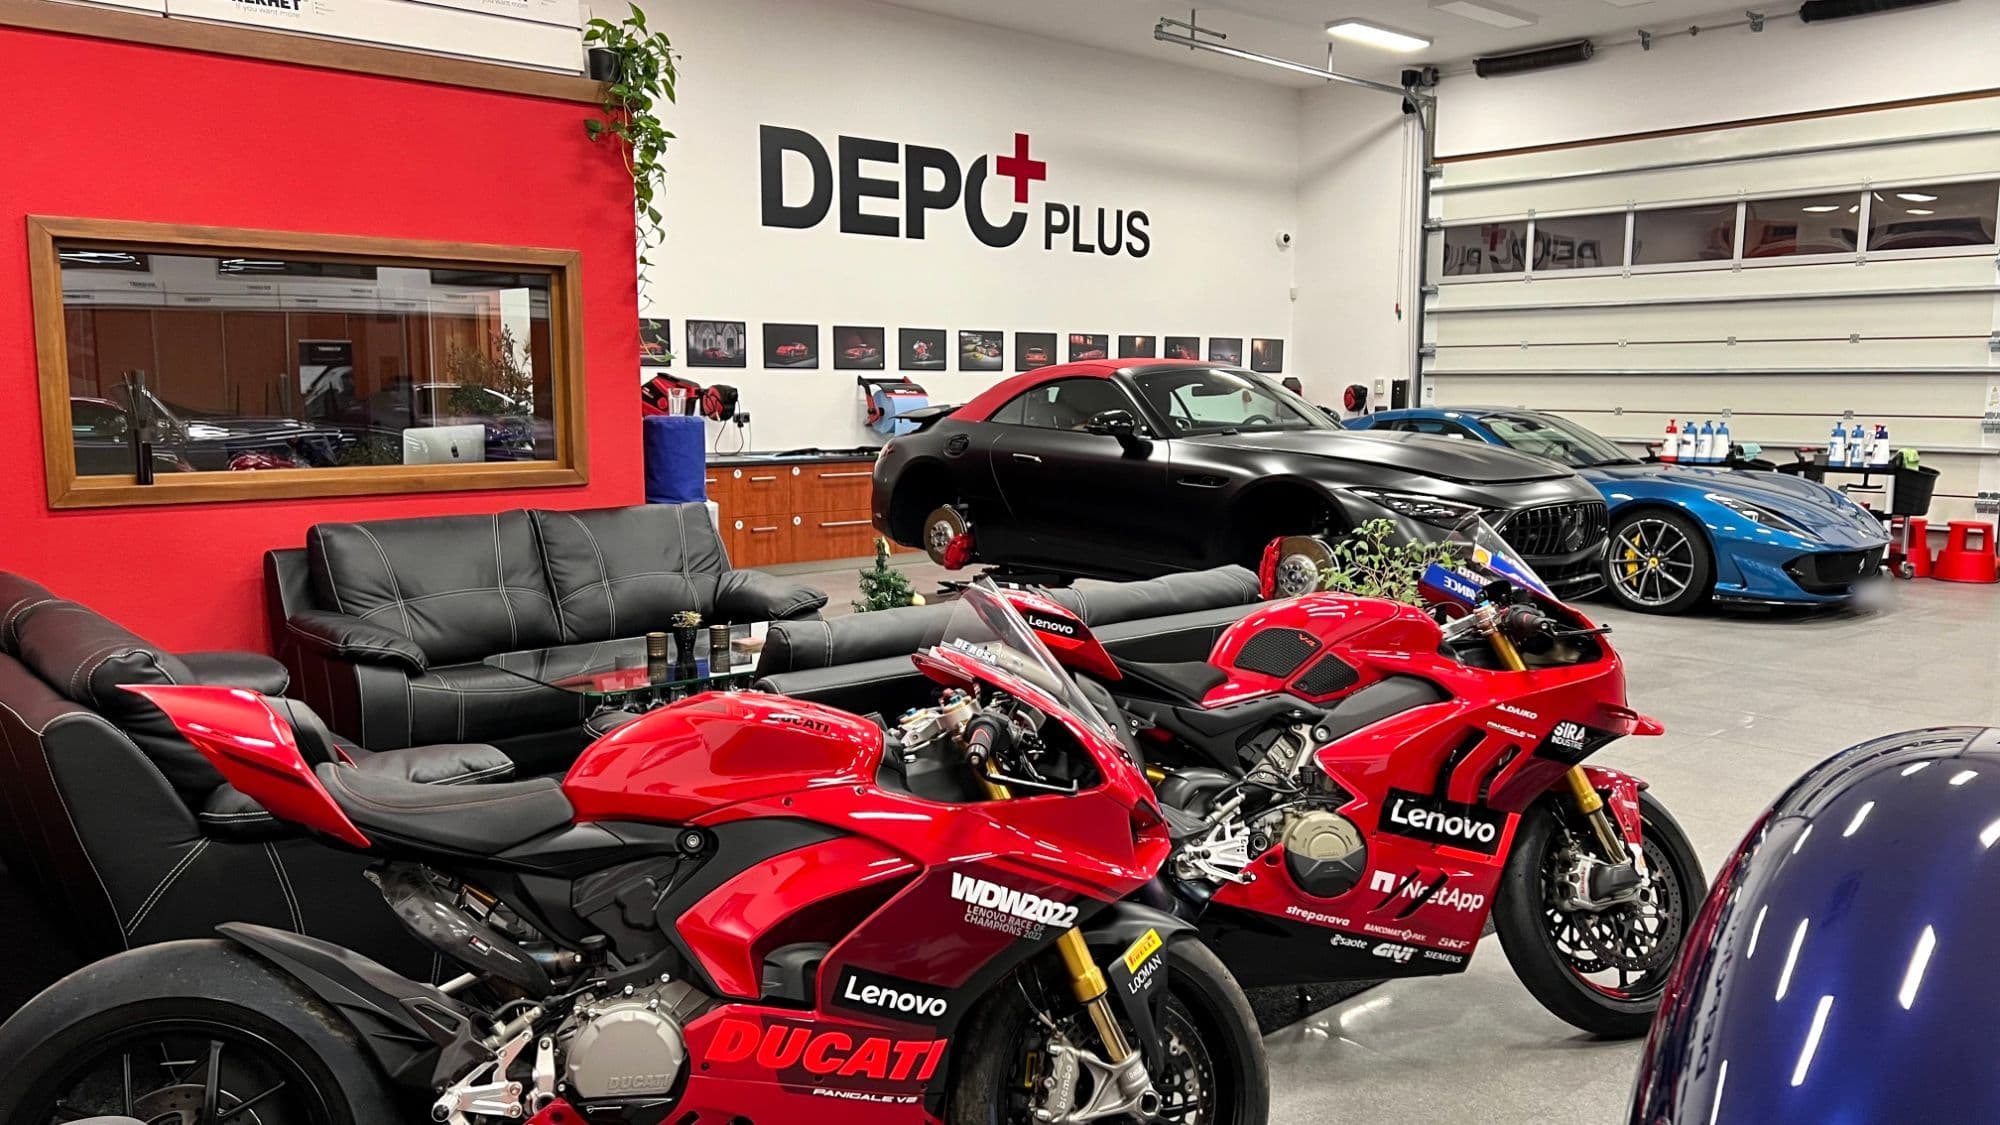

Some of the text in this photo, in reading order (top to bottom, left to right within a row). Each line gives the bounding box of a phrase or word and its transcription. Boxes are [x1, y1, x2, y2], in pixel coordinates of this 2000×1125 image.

[243, 5, 258, 13] you
[259, 8, 278, 16] want
[759, 123, 1028, 249] DEPO
[1044, 201, 1151, 259] PLUS
[1028, 615, 1074, 635] Lenovo
[767, 711, 830, 733] UCATI
[1506, 705, 1538, 720] DAIKO
[1553, 721, 1586, 741] SIRA
[1551, 735, 1585, 751] INDUSTRIE
[1390, 798, 1496, 843] Lenovo
[951, 871, 1080, 929] WDW2022
[1399, 876, 1485, 913] NetApp
[964, 913, 1043, 941] CHAMPIONS 2022
[966, 904, 1047, 933] LENOVO RACE OF
[1285, 905, 1351, 927] streparava
[1363, 923, 1402, 937] BANCOMAT
[1437, 936, 1471, 949] SKF
[1423, 950, 1463, 964] SIEMENS
[1127, 954, 1163, 995] LOCMAN
[844, 975, 948, 1017] Lenovo
[703, 1018, 949, 1082] DUCATI
[607, 1073, 671, 1091] DUCATI
[1056, 1065, 1073, 1110] brembo
[812, 1087, 895, 1103] PANIGALE
